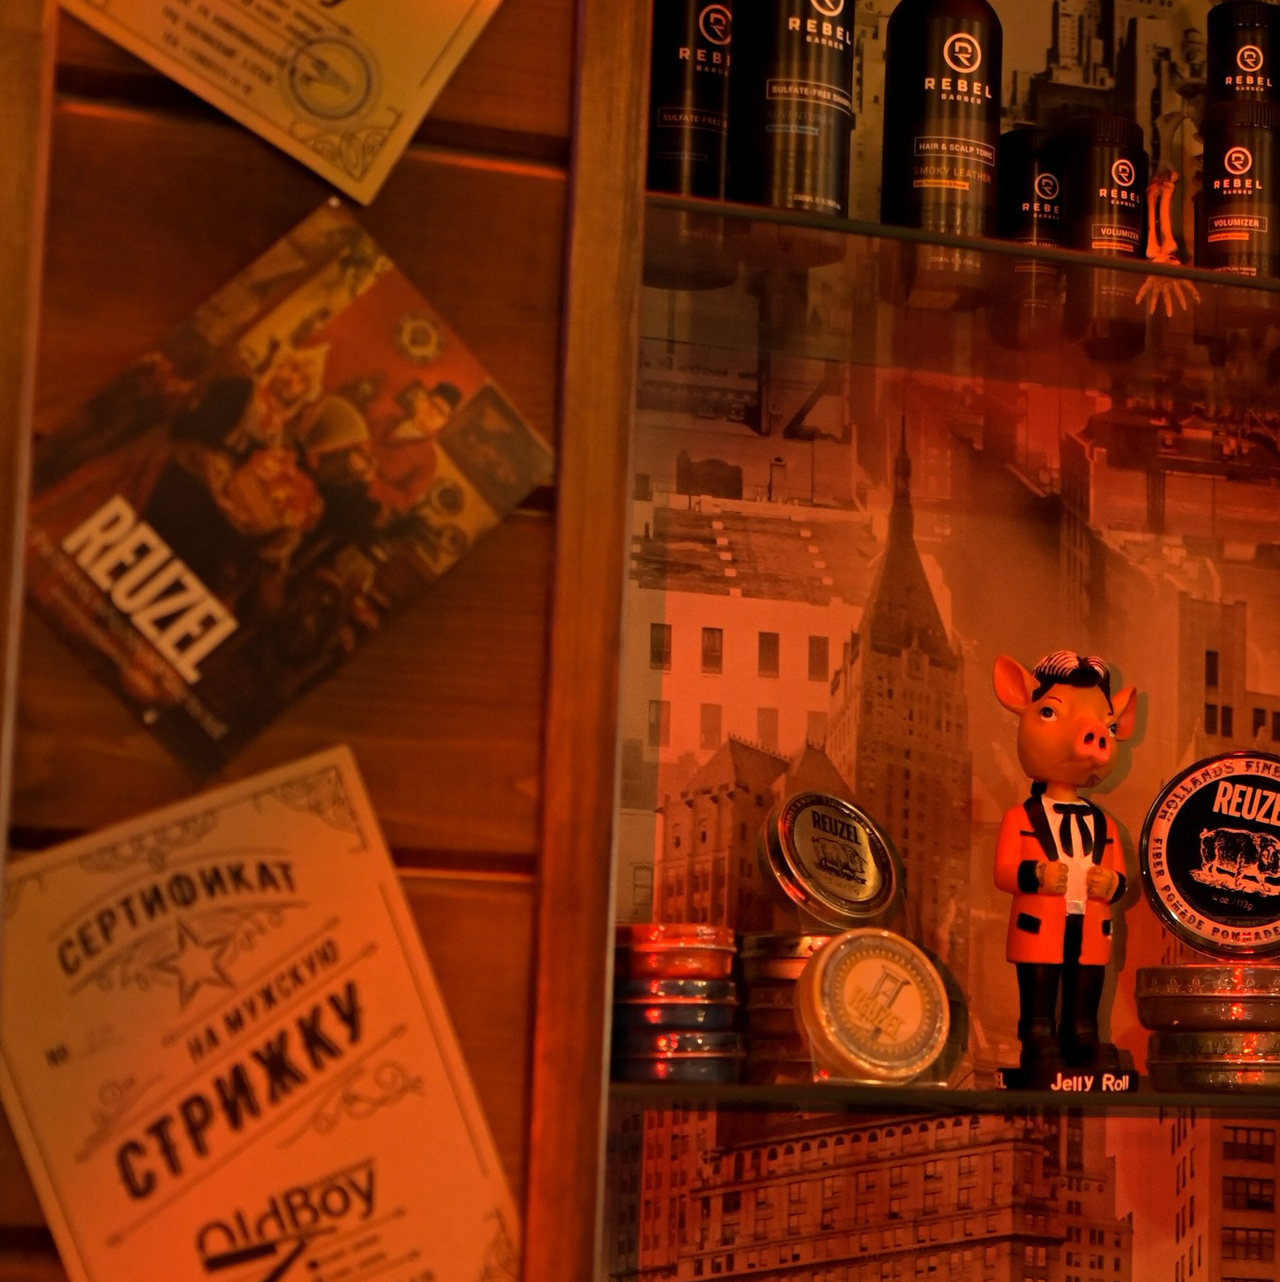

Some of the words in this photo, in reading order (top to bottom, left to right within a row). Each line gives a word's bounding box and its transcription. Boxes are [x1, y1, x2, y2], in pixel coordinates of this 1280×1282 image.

[788, 16, 852, 45] REBEL
[924, 77, 992, 99] REBEL
[1225, 75, 1273, 88] REBEL
[941, 92, 982, 105] BARBER
[919, 142, 939, 150] HAIR
[949, 143, 975, 154] SCALP
[1213, 178, 1263, 190] REBEL
[1022, 203, 1060, 214] REBE
[1101, 227, 1139, 241] VOLUMIZER
[1214, 219, 1259, 228] VOLUMIZER
[61, 494, 240, 685] REUZEL
[811, 809, 862, 845] REUZEL
[1152, 838, 1166, 879] FIBER
[56, 860, 297, 977] СЕРТИФИКАТ
[187, 1030, 220, 1065] НА
[222, 939, 341, 1040] МУЖСКУЮ
[115, 980, 366, 1202] СТРИЖКУ
[1050, 1071, 1095, 1092] Jelly
[1101, 1073, 1130, 1092] Roll
[196, 1160, 378, 1262] OldBoy
